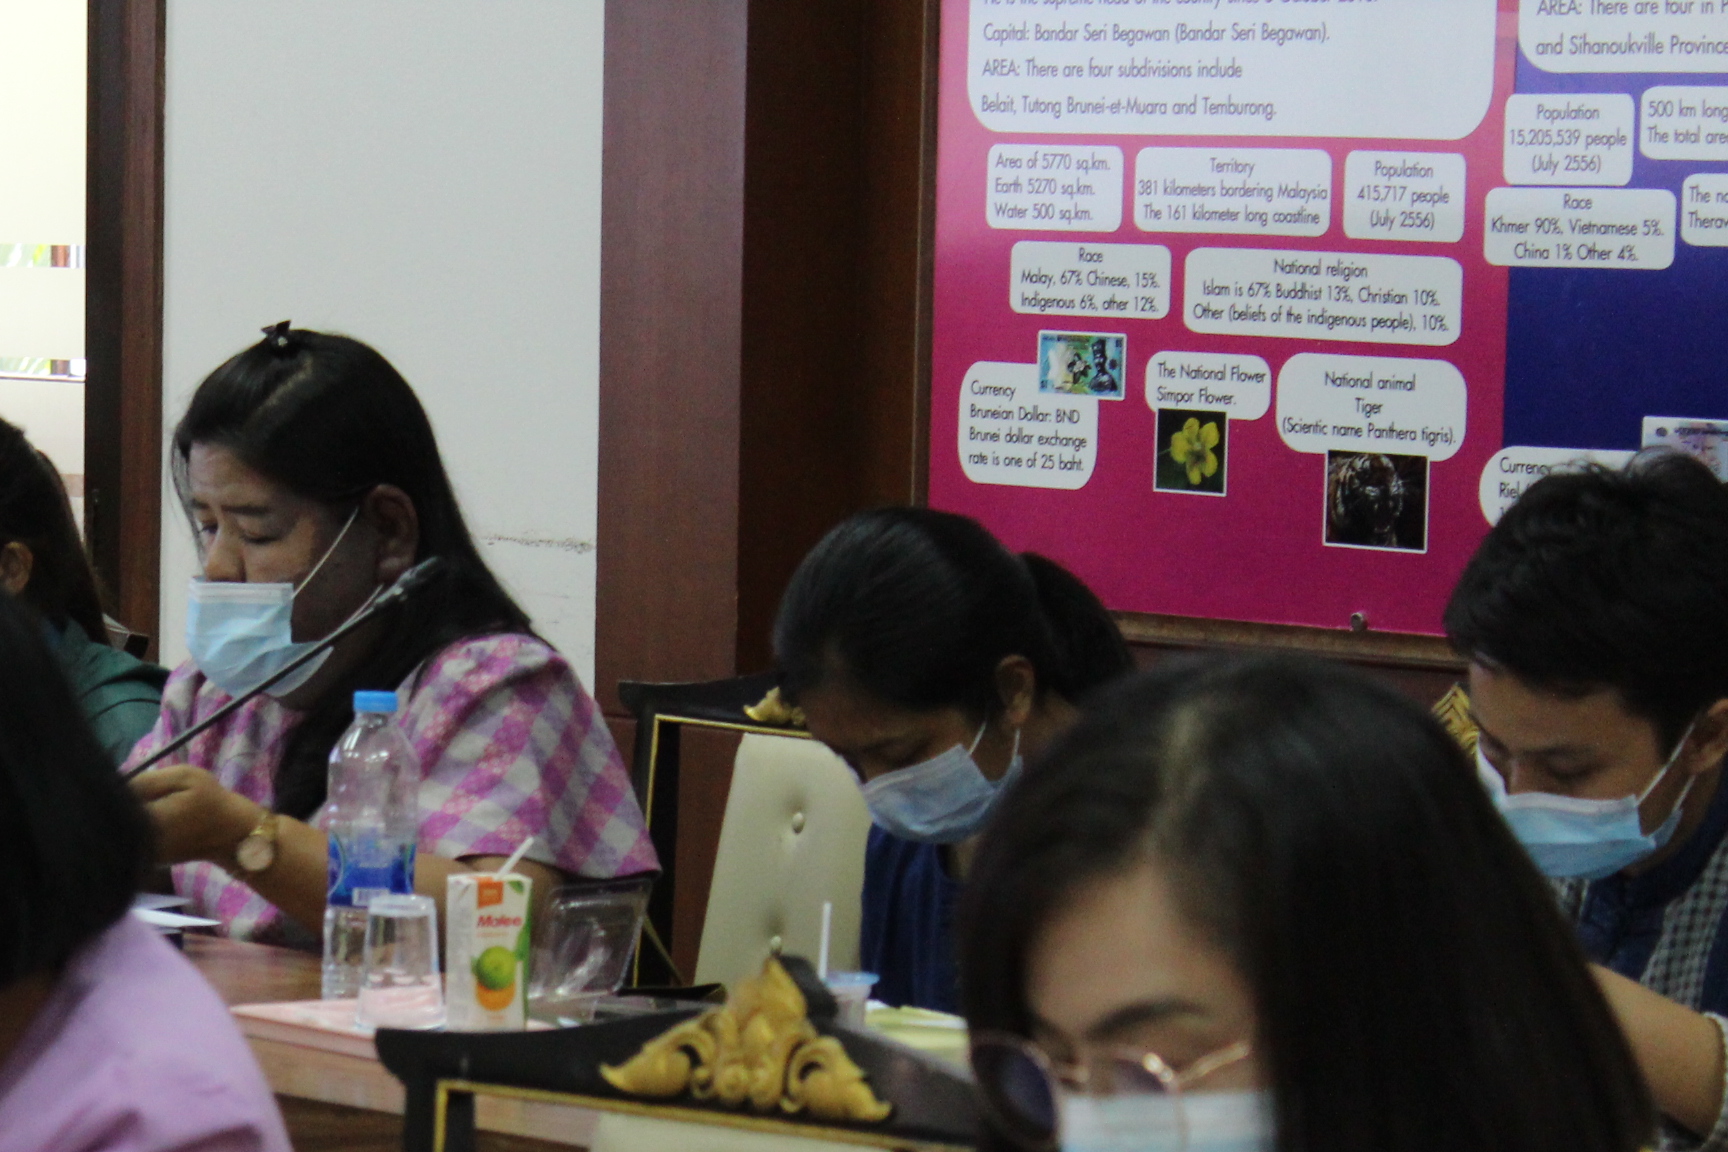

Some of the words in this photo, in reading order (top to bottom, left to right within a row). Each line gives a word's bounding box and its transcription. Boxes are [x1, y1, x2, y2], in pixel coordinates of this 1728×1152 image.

[1536, 0, 1582, 14] AREA:
[1590, 0, 1628, 14] There
[1634, 1, 1658, 14] are
[983, 21, 1029, 46] Capital:
[1035, 21, 1078, 42] Bandar
[1084, 23, 1107, 41] Seri
[1113, 24, 1169, 46] Begawan
[1175, 21, 1225, 43] (Bandar
[1232, 23, 1255, 40] Seri
[1261, 22, 1330, 45] Begawan).
[1536, 33, 1563, 54] and
[1569, 32, 1664, 54] Sihanoukville
[982, 59, 1020, 76] AREA:
[1026, 57, 1058, 77] There
[1063, 65, 1083, 77] are
[1089, 57, 1113, 77] four
[1118, 57, 1191, 77] subdivisions
[1197, 57, 1243, 77] include
[1022, 95, 1061, 119] Tutong
[1172, 95, 1197, 114] and
[1537, 102, 1599, 122] Population
[1648, 101, 1673, 117] 500
[1679, 98, 1697, 117] km
[1702, 98, 1728, 122] long
[1585, 128, 1627, 150] people
[1648, 125, 1669, 143] The
[1674, 125, 1700, 143] total
[995, 153, 1022, 169] Area
[1027, 152, 1039, 169] of
[1042, 154, 1071, 170] 5770
[1210, 158, 1255, 177] Territory
[1374, 160, 1433, 179] Population
[1532, 154, 1559, 175] (July
[1564, 156, 1602, 173] 2556)
[995, 177, 1021, 193] Earth
[1027, 179, 1056, 194] 5270
[1138, 180, 1158, 196] 381
[1164, 179, 1216, 197] kilometers
[1220, 180, 1272, 201] bordering
[1277, 184, 1327, 203] Malaysia
[1689, 185, 1711, 203] The
[1411, 186, 1449, 206] people
[1563, 194, 1592, 209] Race
[994, 203, 1027, 218] Water
[1033, 204, 1054, 219] 500
[1143, 204, 1162, 220] The
[1167, 205, 1187, 220] 161
[1192, 204, 1239, 222] kilometer
[1245, 206, 1267, 226] long
[1273, 207, 1319, 225] coastline
[1370, 209, 1395, 228] (July
[1400, 212, 1435, 231] 2556)
[1491, 216, 1530, 234] Khmer
[1568, 219, 1637, 236] Vietnamese
[1079, 248, 1103, 263] Race
[1514, 243, 1549, 259] China
[1556, 244, 1572, 260] 1%
[1577, 244, 1612, 260] Other
[1060, 270, 1083, 286] 67%
[1274, 259, 1320, 276] National
[1327, 260, 1368, 281] religion
[1021, 291, 1075, 311] Indigenous
[1102, 293, 1128, 311] other
[1203, 280, 1230, 297] Islam
[1235, 283, 1243, 297] is
[1247, 282, 1271, 299] 67%
[1276, 283, 1322, 300] Buddhist
[1358, 287, 1407, 305] Christian
[1193, 303, 1224, 320] Other
[1271, 305, 1283, 323] of
[1287, 305, 1302, 324] the
[1307, 307, 1366, 330] indigenous
[1157, 363, 1176, 378] The
[1180, 364, 1226, 381] National
[1231, 365, 1266, 384] Flower
[1324, 371, 1372, 388] National
[1377, 374, 1416, 391] animal
[971, 381, 1015, 400] Currency
[1157, 387, 1194, 406] Simpor
[970, 404, 1014, 420] Bruneian
[1056, 409, 1080, 424] BND
[1355, 398, 1383, 418] Tiger
[969, 427, 1000, 442] Brunei
[1004, 428, 1033, 444] dollar
[1038, 431, 1087, 450] exchange
[1332, 426, 1362, 437] name
[1368, 422, 1417, 441] Panthera
[969, 452, 988, 466] rate
[993, 453, 1000, 467] is
[1004, 457, 1023, 468] one
[1026, 454, 1037, 468] of
[1041, 456, 1055, 470] 25
